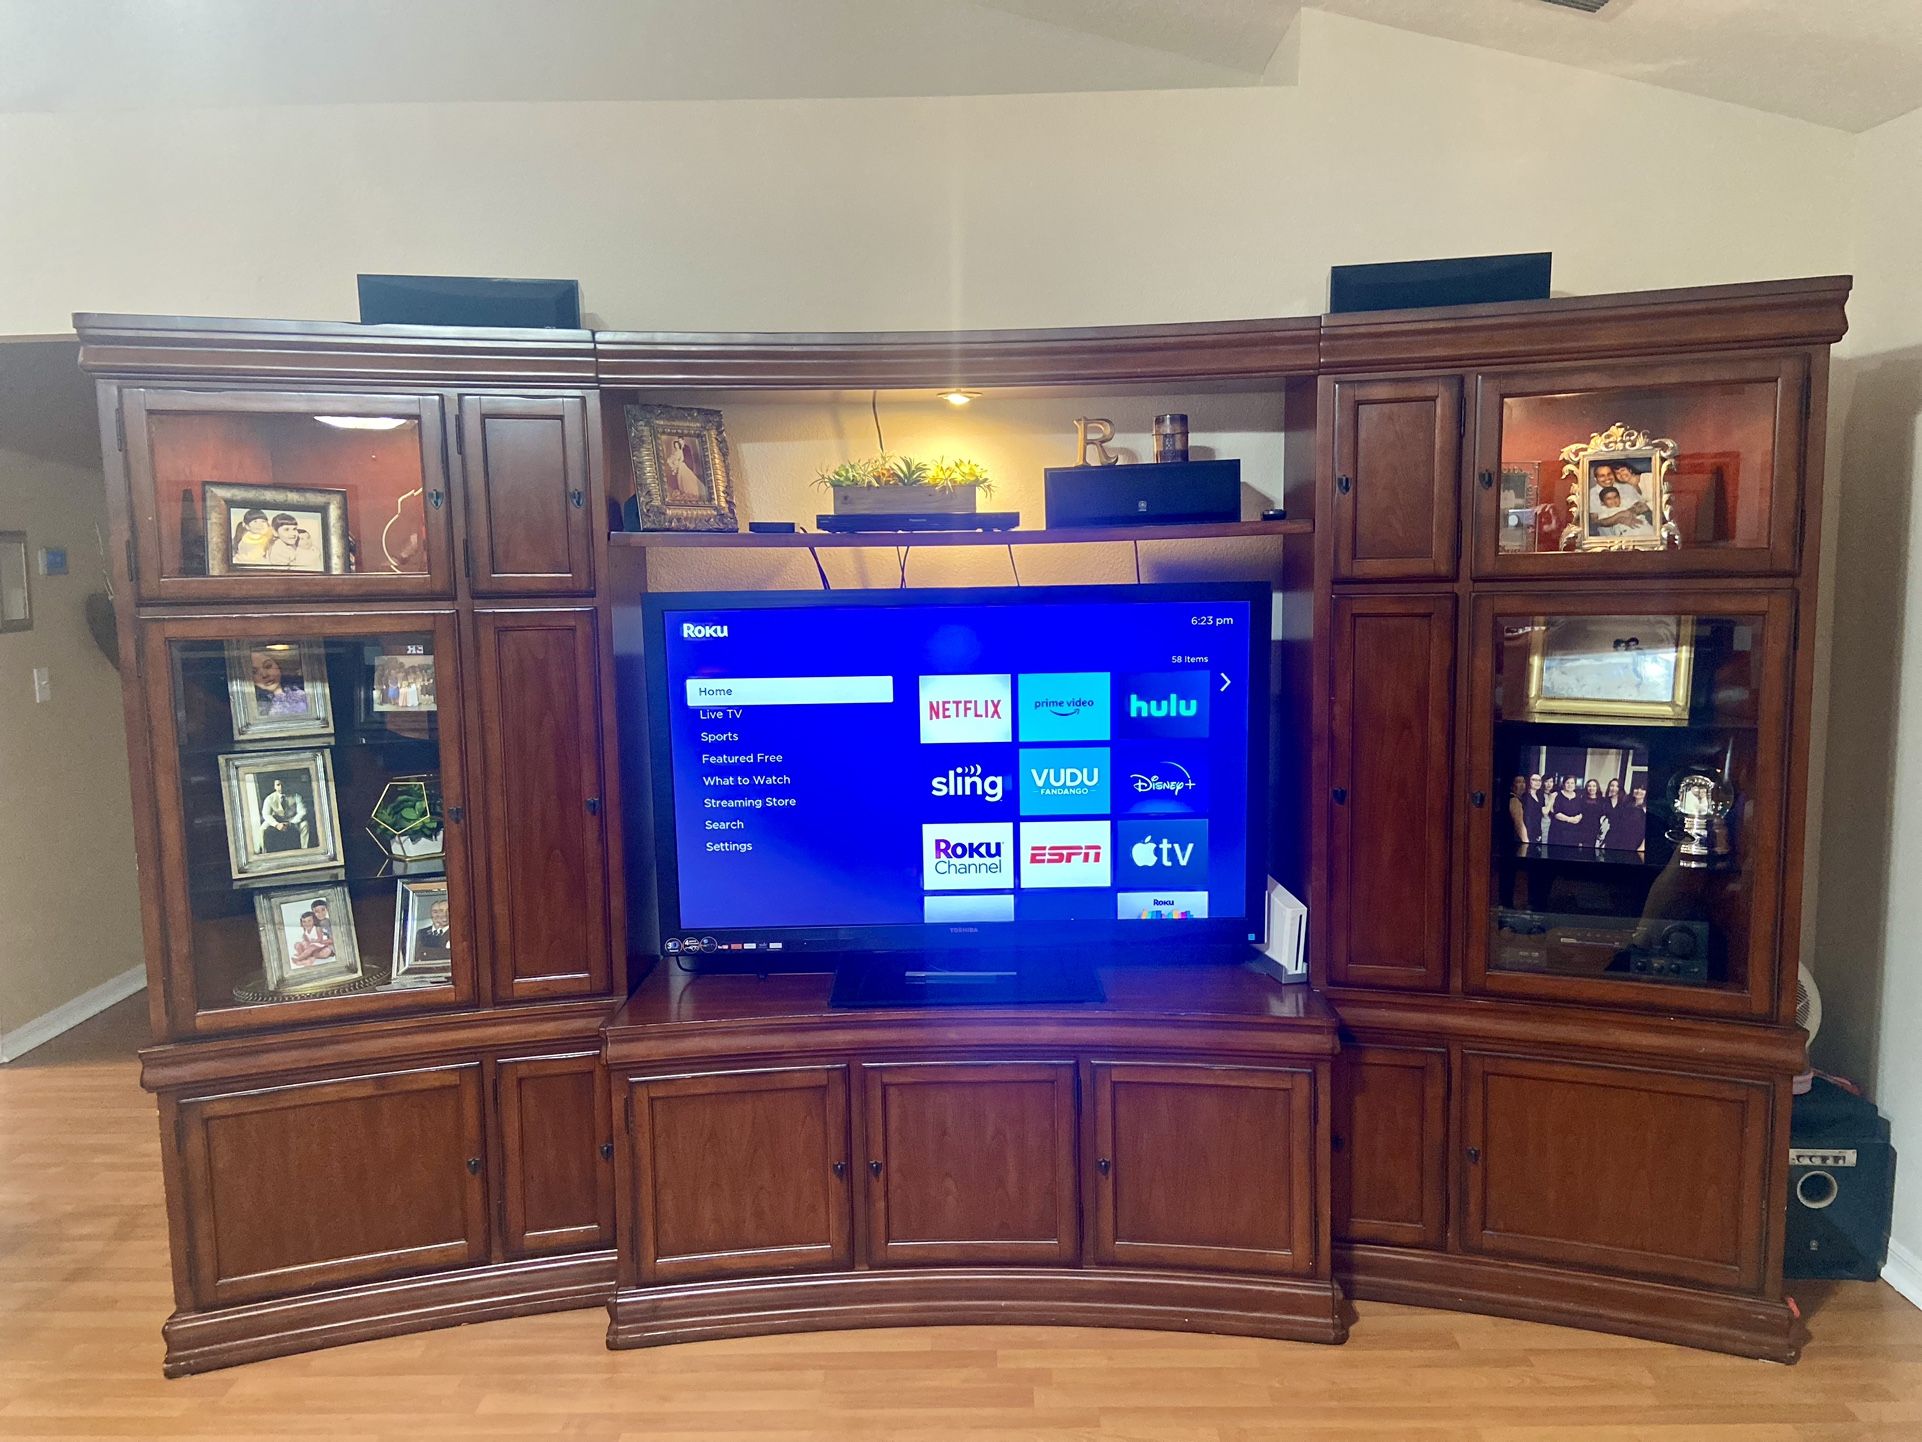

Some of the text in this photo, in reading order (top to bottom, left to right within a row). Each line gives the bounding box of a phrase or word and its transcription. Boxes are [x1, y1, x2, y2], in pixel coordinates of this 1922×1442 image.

[1073, 416, 1118, 466] R
[1191, 616, 1234, 627] 6:23 pm
[1171, 655, 1209, 664] 58 Items
[699, 686, 733, 697] Home
[929, 700, 1002, 720] NETFLIX
[1034, 698, 1094, 711] prime video
[1130, 694, 1197, 717] hulu
[700, 708, 743, 720] Live TV
[701, 731, 739, 743] Sports
[702, 752, 783, 764] Featured Free
[703, 774, 791, 786] What to Watch
[931, 764, 1003, 802] sling
[1031, 767, 1099, 788] VUDU
[1040, 787, 1088, 796] FANDANGO
[704, 796, 797, 809] Streaming Store
[705, 819, 744, 830] Search
[706, 841, 752, 853] Settings
[1161, 838, 1195, 867] tv
[1029, 844, 1102, 864] ESPN
[935, 859, 1002, 875] Channel
